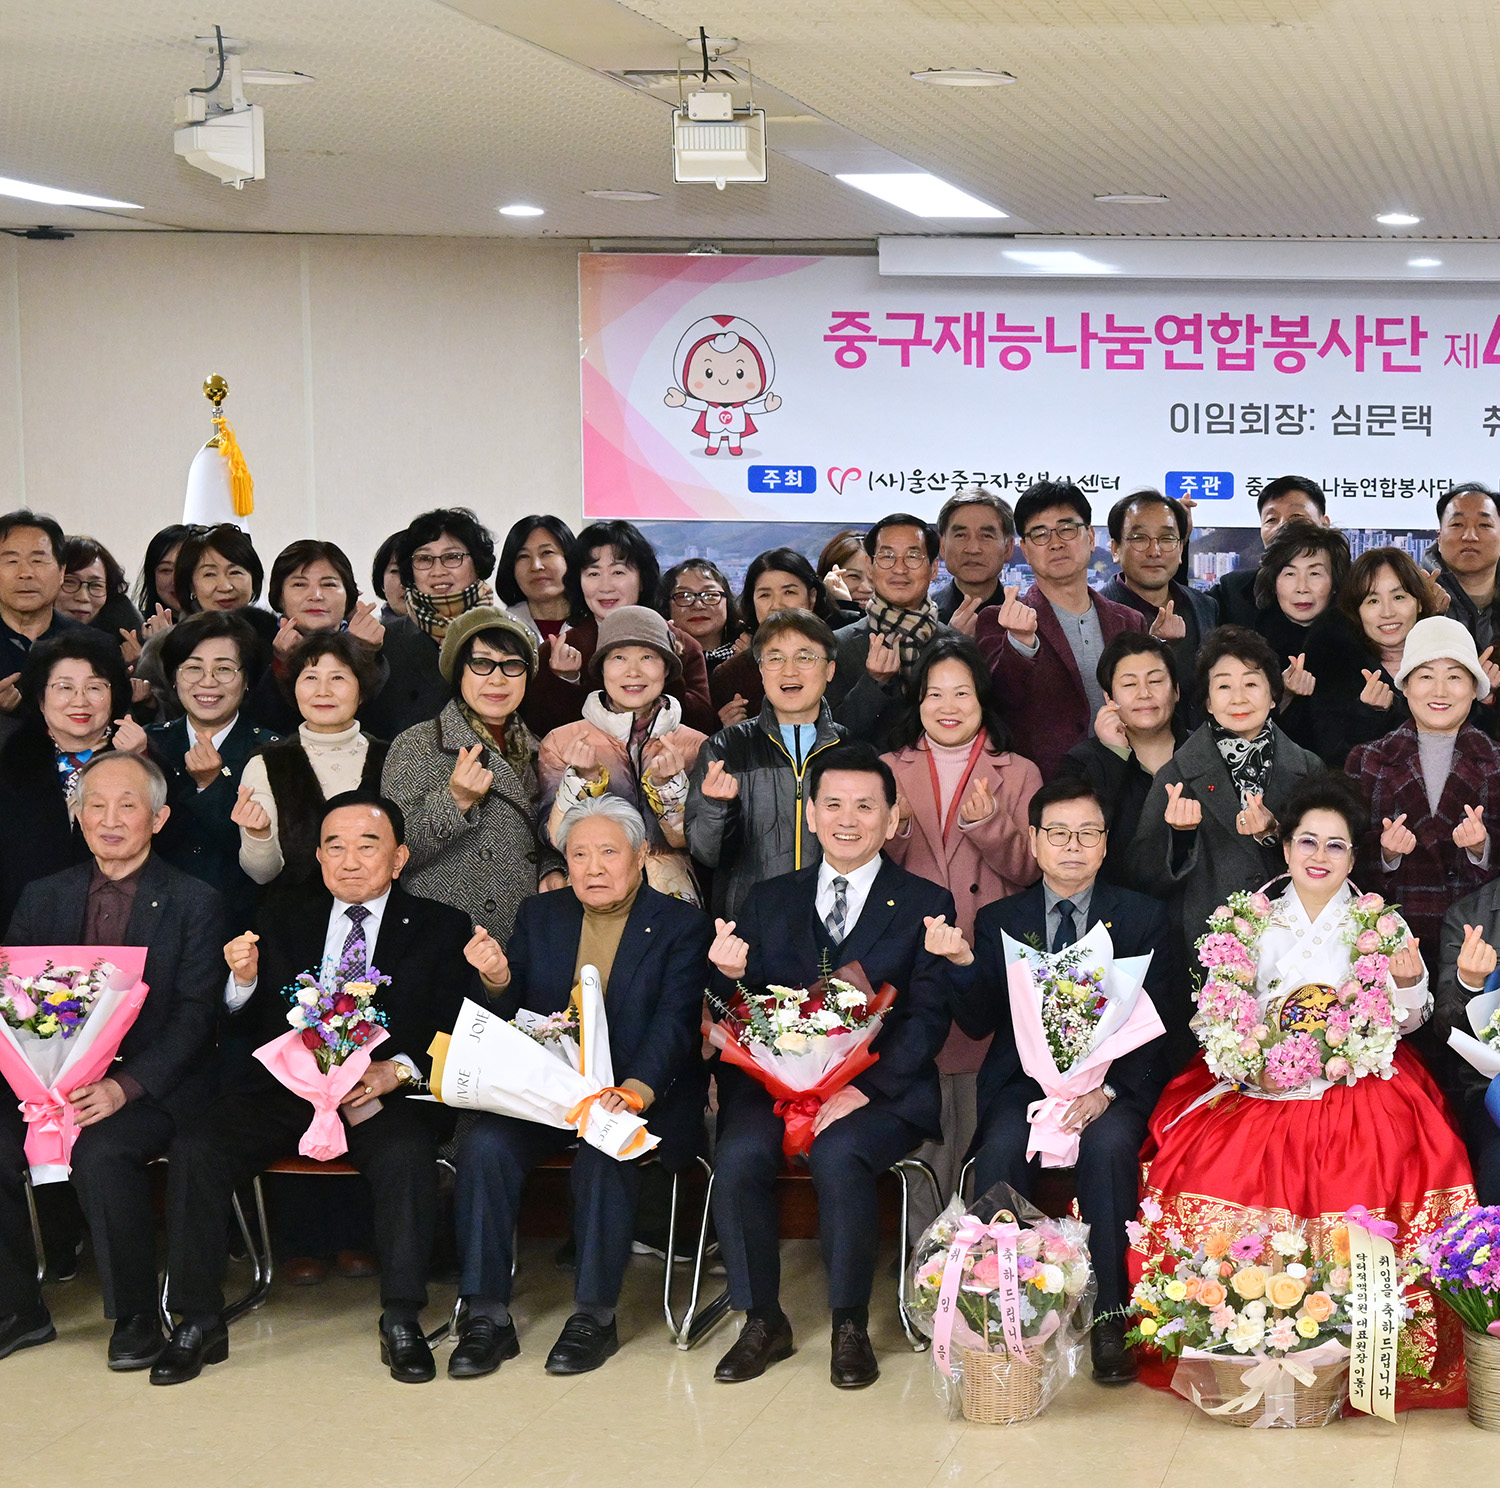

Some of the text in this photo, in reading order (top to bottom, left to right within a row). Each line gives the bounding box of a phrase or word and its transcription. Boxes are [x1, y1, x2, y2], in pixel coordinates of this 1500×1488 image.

[823, 311, 1429, 375] 중구재능나눔연합봉사단
[1169, 402, 1433, 438] 이임회장: 심문택
[762, 469, 803, 489] 주최
[1179, 475, 1222, 497] 주관
[1245, 475, 1456, 499] 중나눔연합봉사단
[469, 1010, 491, 1044] JOIE
[1003, 1248, 1023, 1355] 축하드립니다
[1355, 1318, 1369, 1364] 대표원장
[1379, 1256, 1395, 1400] 취임을 축하드립니다
